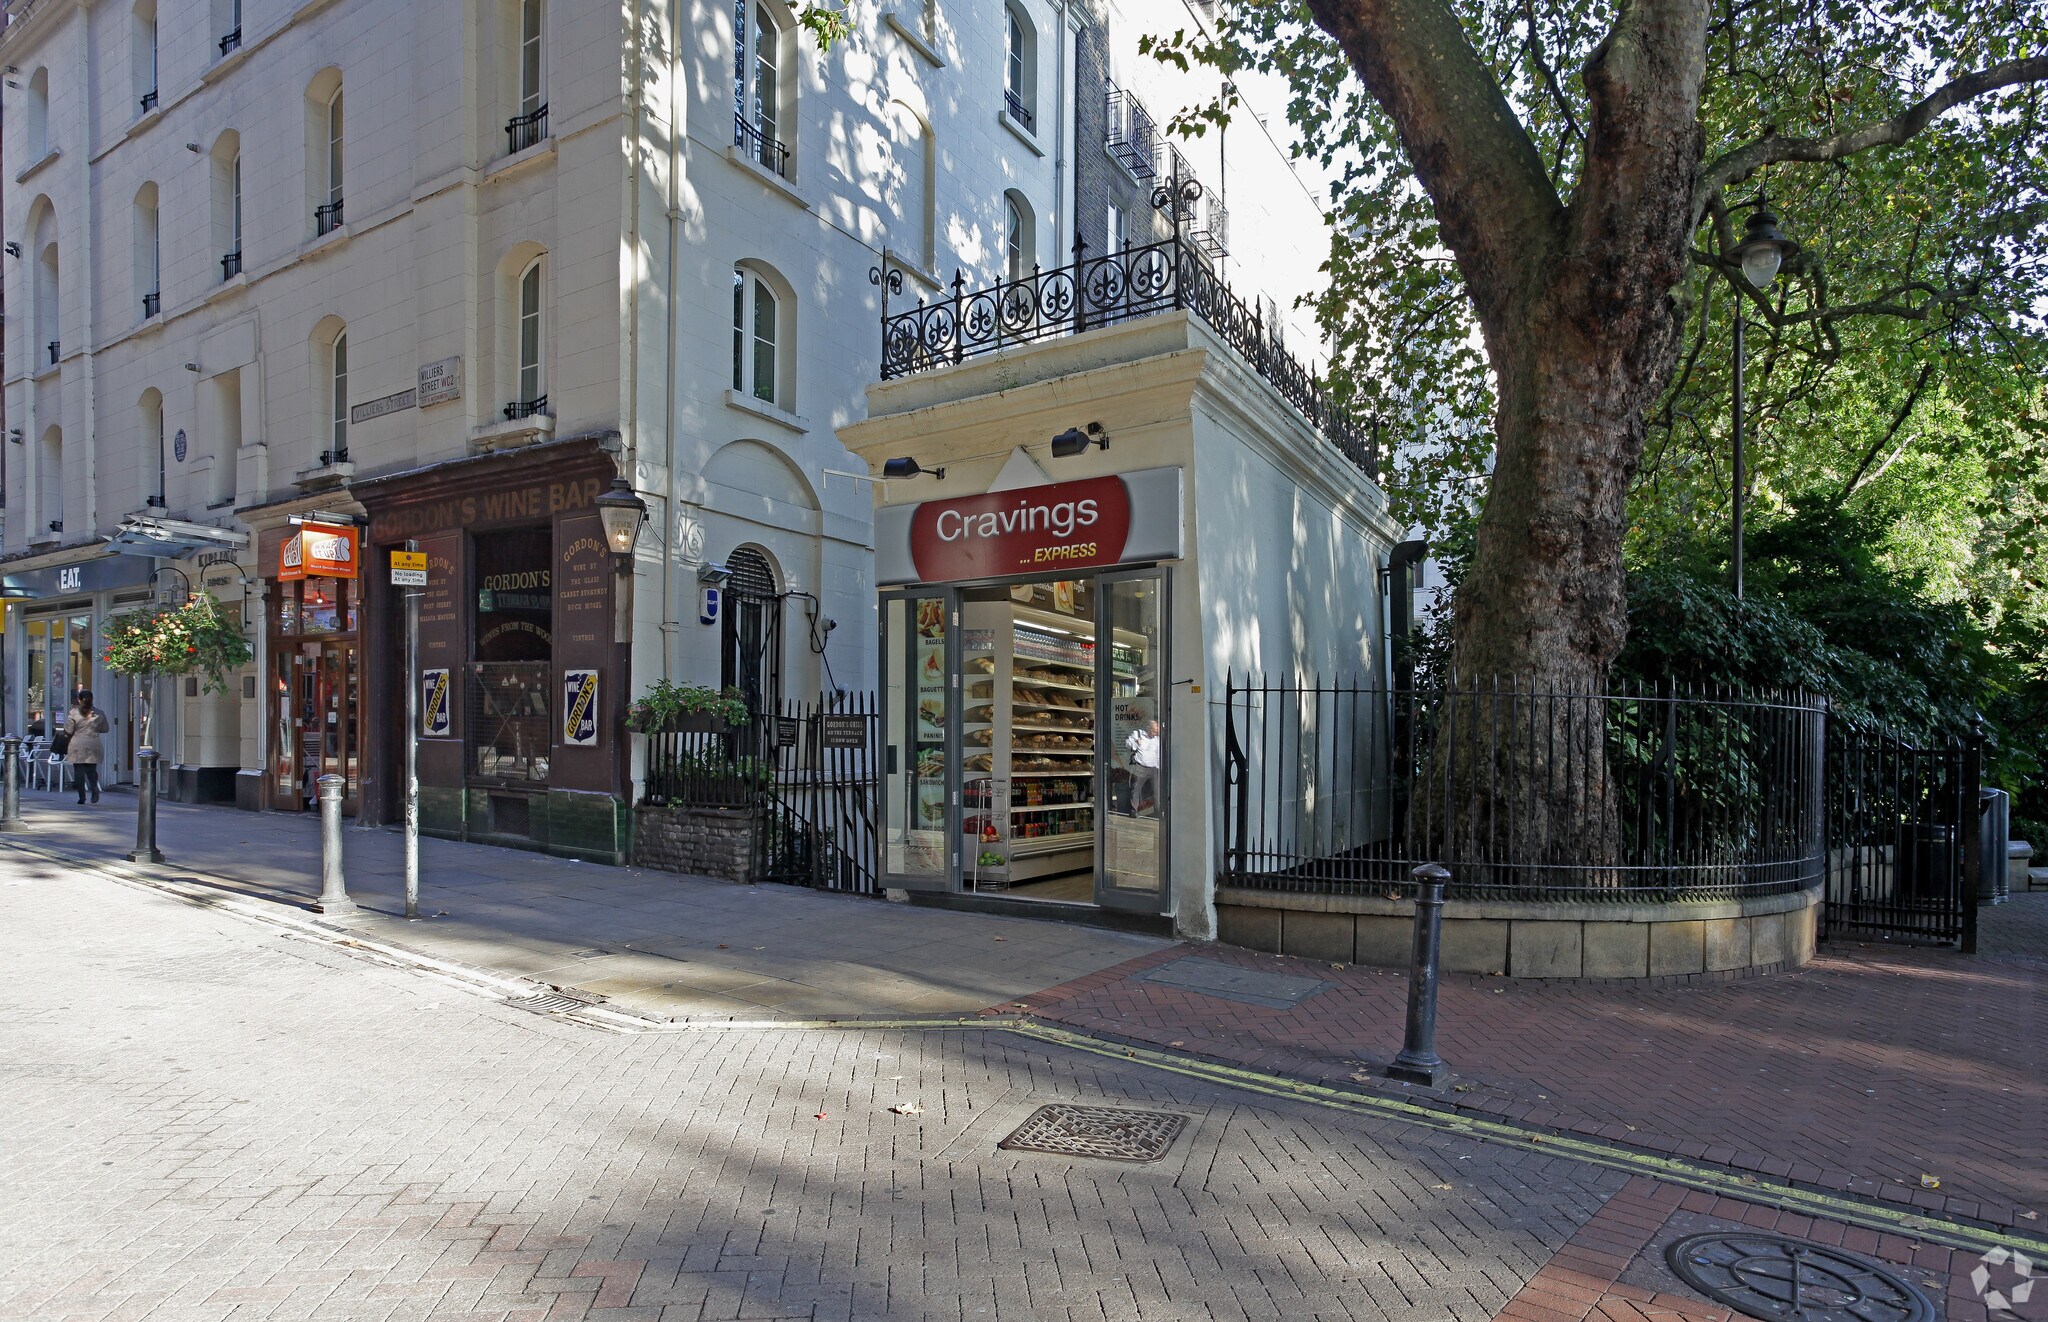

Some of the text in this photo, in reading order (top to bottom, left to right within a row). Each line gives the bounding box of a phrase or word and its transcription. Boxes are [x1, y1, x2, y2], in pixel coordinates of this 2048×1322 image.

[421, 365, 443, 381] VILLIERS
[421, 374, 454, 394] STREET WC2
[355, 402, 383, 418] VILLIERS
[373, 478, 600, 540] GORDON'S WINE BAR
[936, 499, 1098, 542] Cravings
[198, 550, 238, 567] KIPLING
[564, 538, 606, 562] GORDON'S
[1034, 542, 1097, 562] EXPRESS
[427, 557, 455, 575] RDON'S
[573, 564, 586, 572] WINE
[60, 568, 80, 589] EAT.
[485, 570, 550, 591] GORDON'S
[580, 588, 608, 596] BURGUNDY
[480, 627, 500, 647] WINES
[501, 622, 519, 632] FROM
[521, 622, 534, 632] THE
[425, 679, 435, 690] WINE
[567, 681, 579, 693] WINE
[426, 676, 447, 726] GORDON'S
[567, 679, 595, 734] GORDON'S
[436, 712, 446, 723] BAR
[581, 719, 592, 731] BAR
